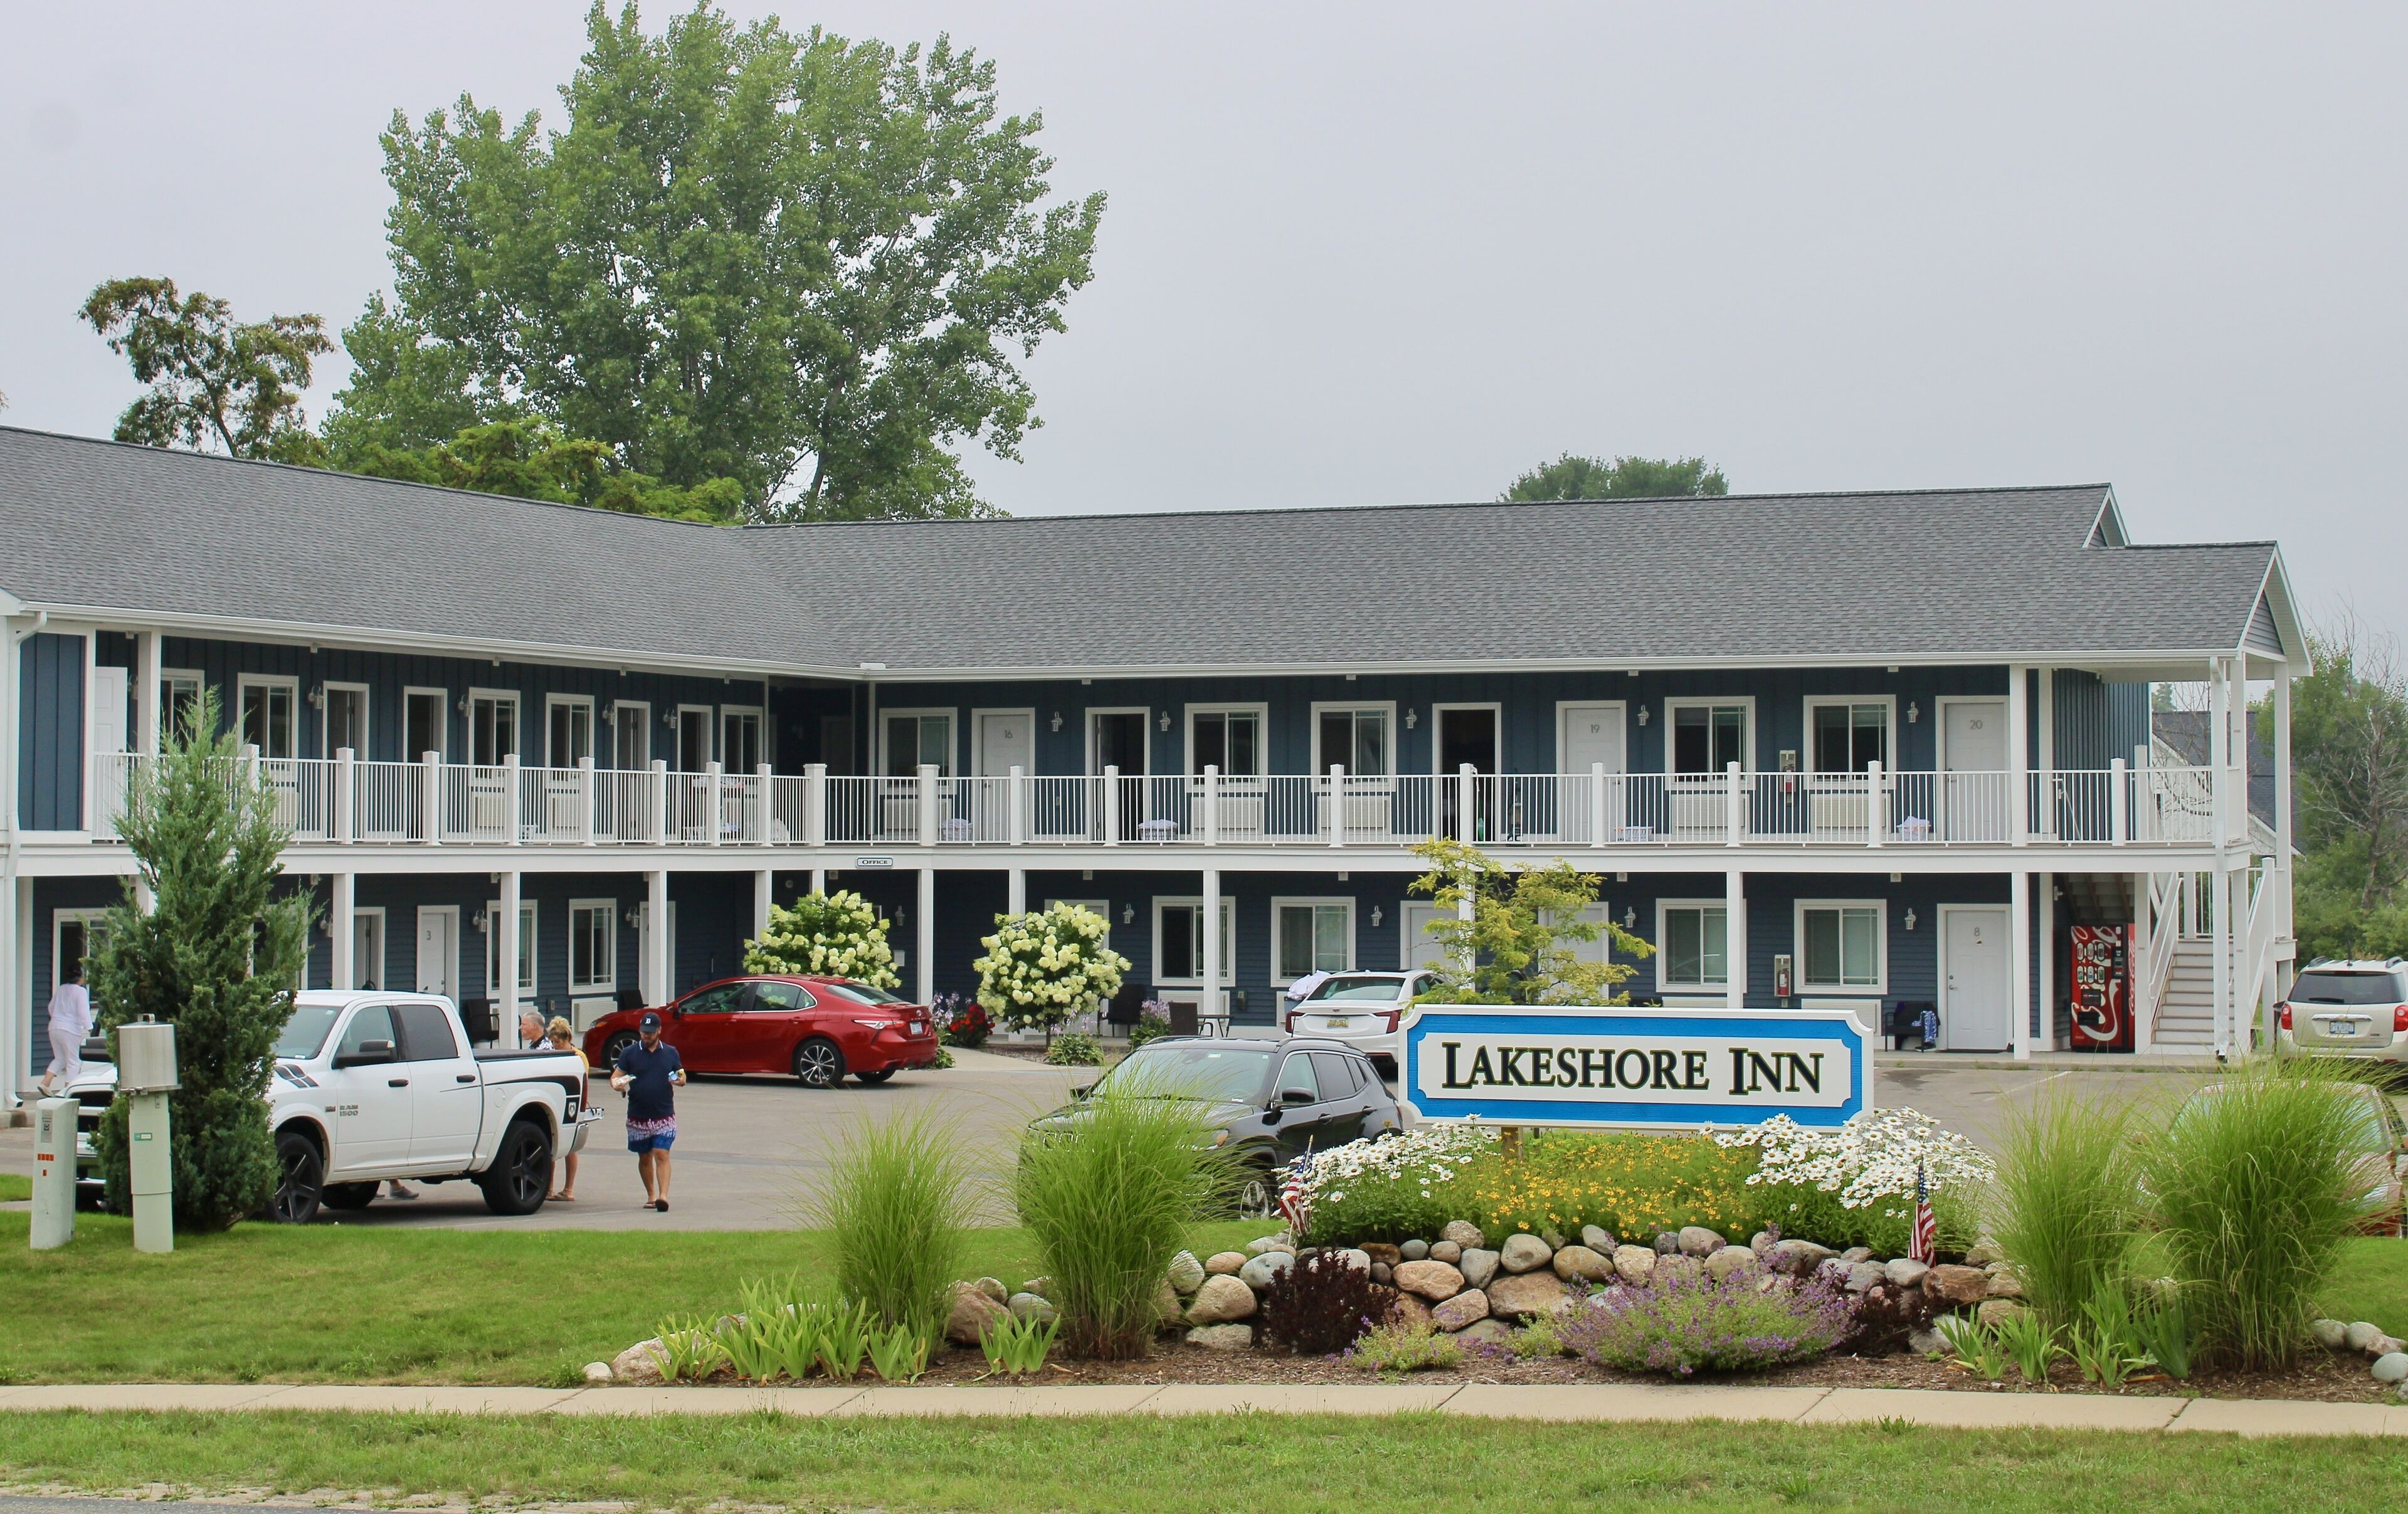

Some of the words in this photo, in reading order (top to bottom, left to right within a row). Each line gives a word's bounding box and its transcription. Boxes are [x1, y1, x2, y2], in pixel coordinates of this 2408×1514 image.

[1591, 724, 1600, 733] 19
[1970, 720, 1983, 730] 20
[1005, 730, 1013, 739] 16
[426, 930, 431, 940] 3
[1974, 927, 1980, 937] 8
[1442, 1042, 1710, 1090] LAKESHORE
[1728, 1048, 1824, 1095] INN
